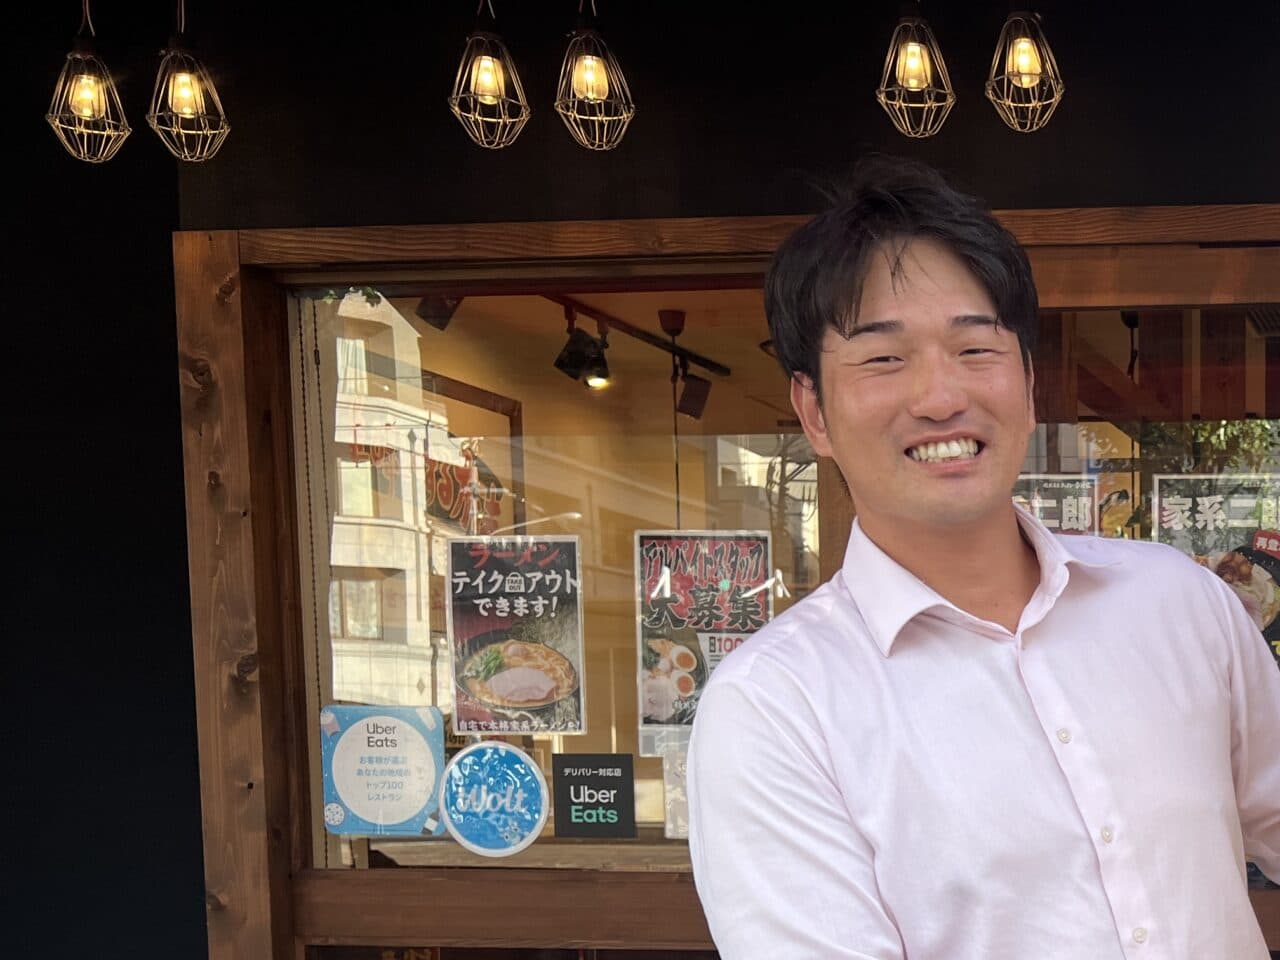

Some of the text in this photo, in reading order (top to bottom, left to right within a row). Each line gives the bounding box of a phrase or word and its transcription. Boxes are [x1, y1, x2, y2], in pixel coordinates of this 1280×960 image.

[1012, 495, 1093, 531] 二郎
[469, 543, 560, 569] ラーメン
[643, 541, 763, 581] アルバイトスタッフ
[452, 568, 582, 594] テイク アウト
[473, 596, 558, 618] できます!
[642, 584, 770, 631] 大募集
[366, 723, 397, 735] Uber
[367, 736, 398, 748] Eats
[563, 767, 622, 777] デリバリー対応店
[367, 793, 402, 801] レストラン
[456, 784, 527, 813] Wolt
[570, 785, 617, 803] Uber
[571, 805, 619, 823] Eats
